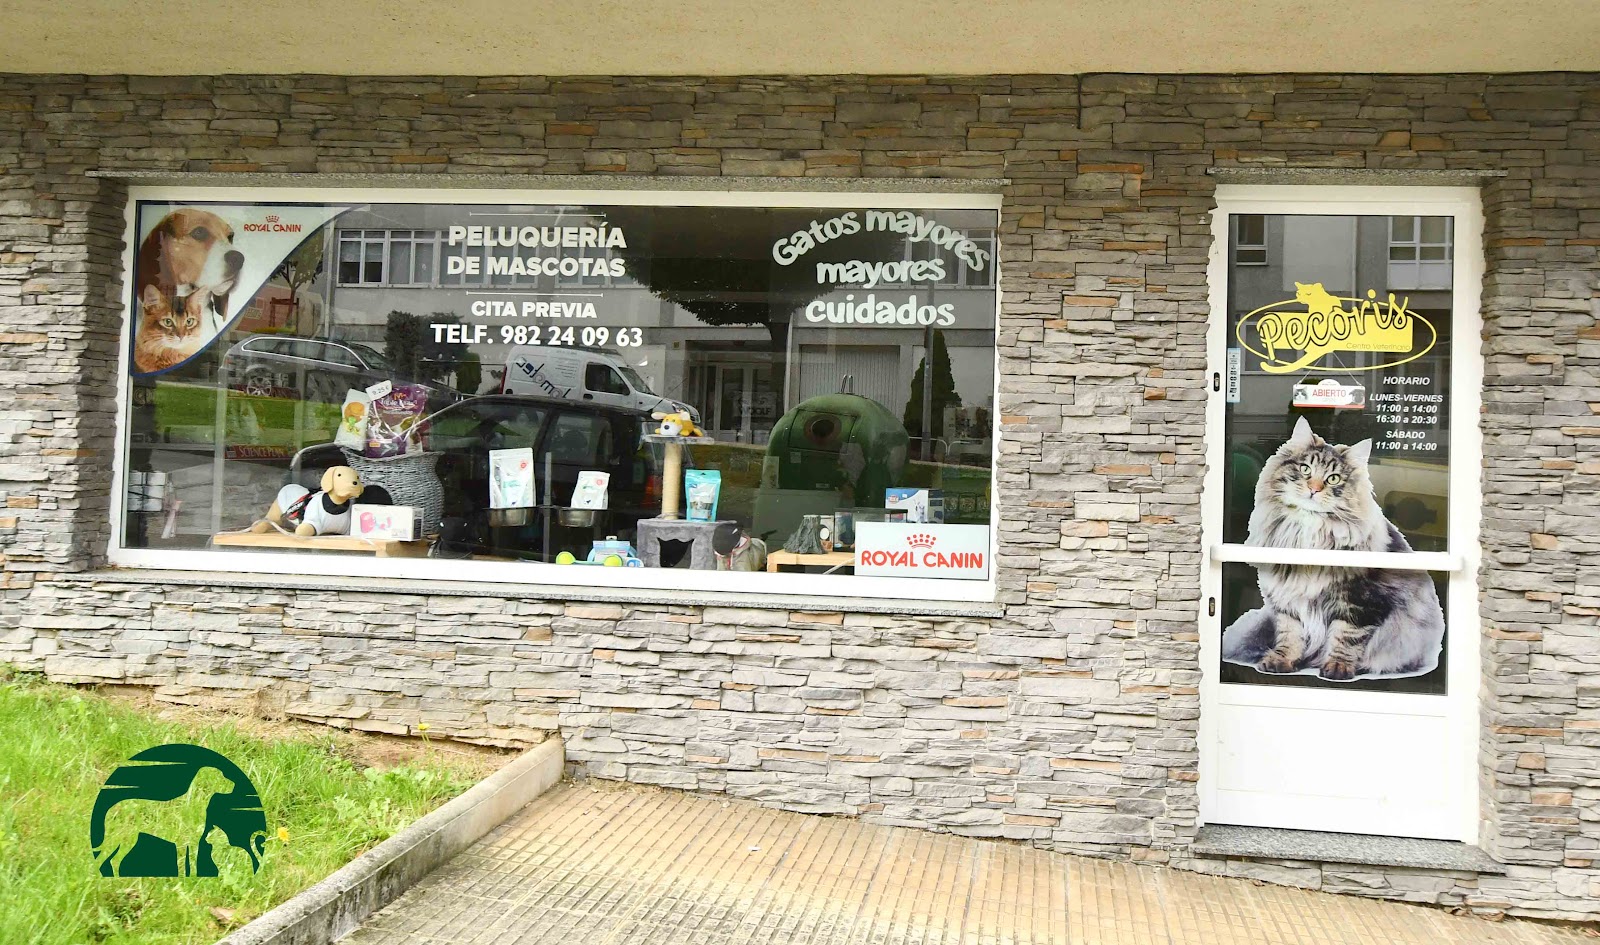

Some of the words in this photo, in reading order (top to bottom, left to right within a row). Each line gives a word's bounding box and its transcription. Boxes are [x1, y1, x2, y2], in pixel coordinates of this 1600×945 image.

[243, 224, 271, 232] ROYAL
[273, 224, 302, 233] CANIN
[448, 222, 627, 248] PELUQUERÍA
[772, 211, 861, 266] Gatos
[865, 210, 991, 272] mayores
[447, 256, 481, 276] DE
[486, 256, 627, 278] MASCOTAS
[815, 257, 946, 289] mayores
[471, 300, 519, 318] CITA
[522, 301, 597, 319] PREVIA
[805, 294, 956, 326] cuidados
[1256, 288, 1409, 361] Pecoris
[430, 323, 493, 345] TELF.
[501, 325, 541, 346] 982
[547, 325, 576, 347] 24
[582, 326, 610, 348] 09
[615, 327, 644, 348] 63
[1346, 342, 1371, 350] Centro
[1383, 376, 1430, 385] HORARIO
[1312, 388, 1347, 398] ABIERTO
[1370, 393, 1442, 403] LUNES-VIERNES
[1376, 404, 1401, 413] 11:00
[1403, 405, 1409, 413] a
[1412, 404, 1437, 413] 14:00
[1376, 415, 1401, 424] 16:30
[1412, 415, 1437, 424] 20:30
[1386, 429, 1426, 439] SÁBADO
[1375, 442, 1401, 451] 11:00
[1412, 442, 1437, 451] 14:00
[861, 550, 918, 568] ROYAL
[923, 552, 983, 569] CANIN
